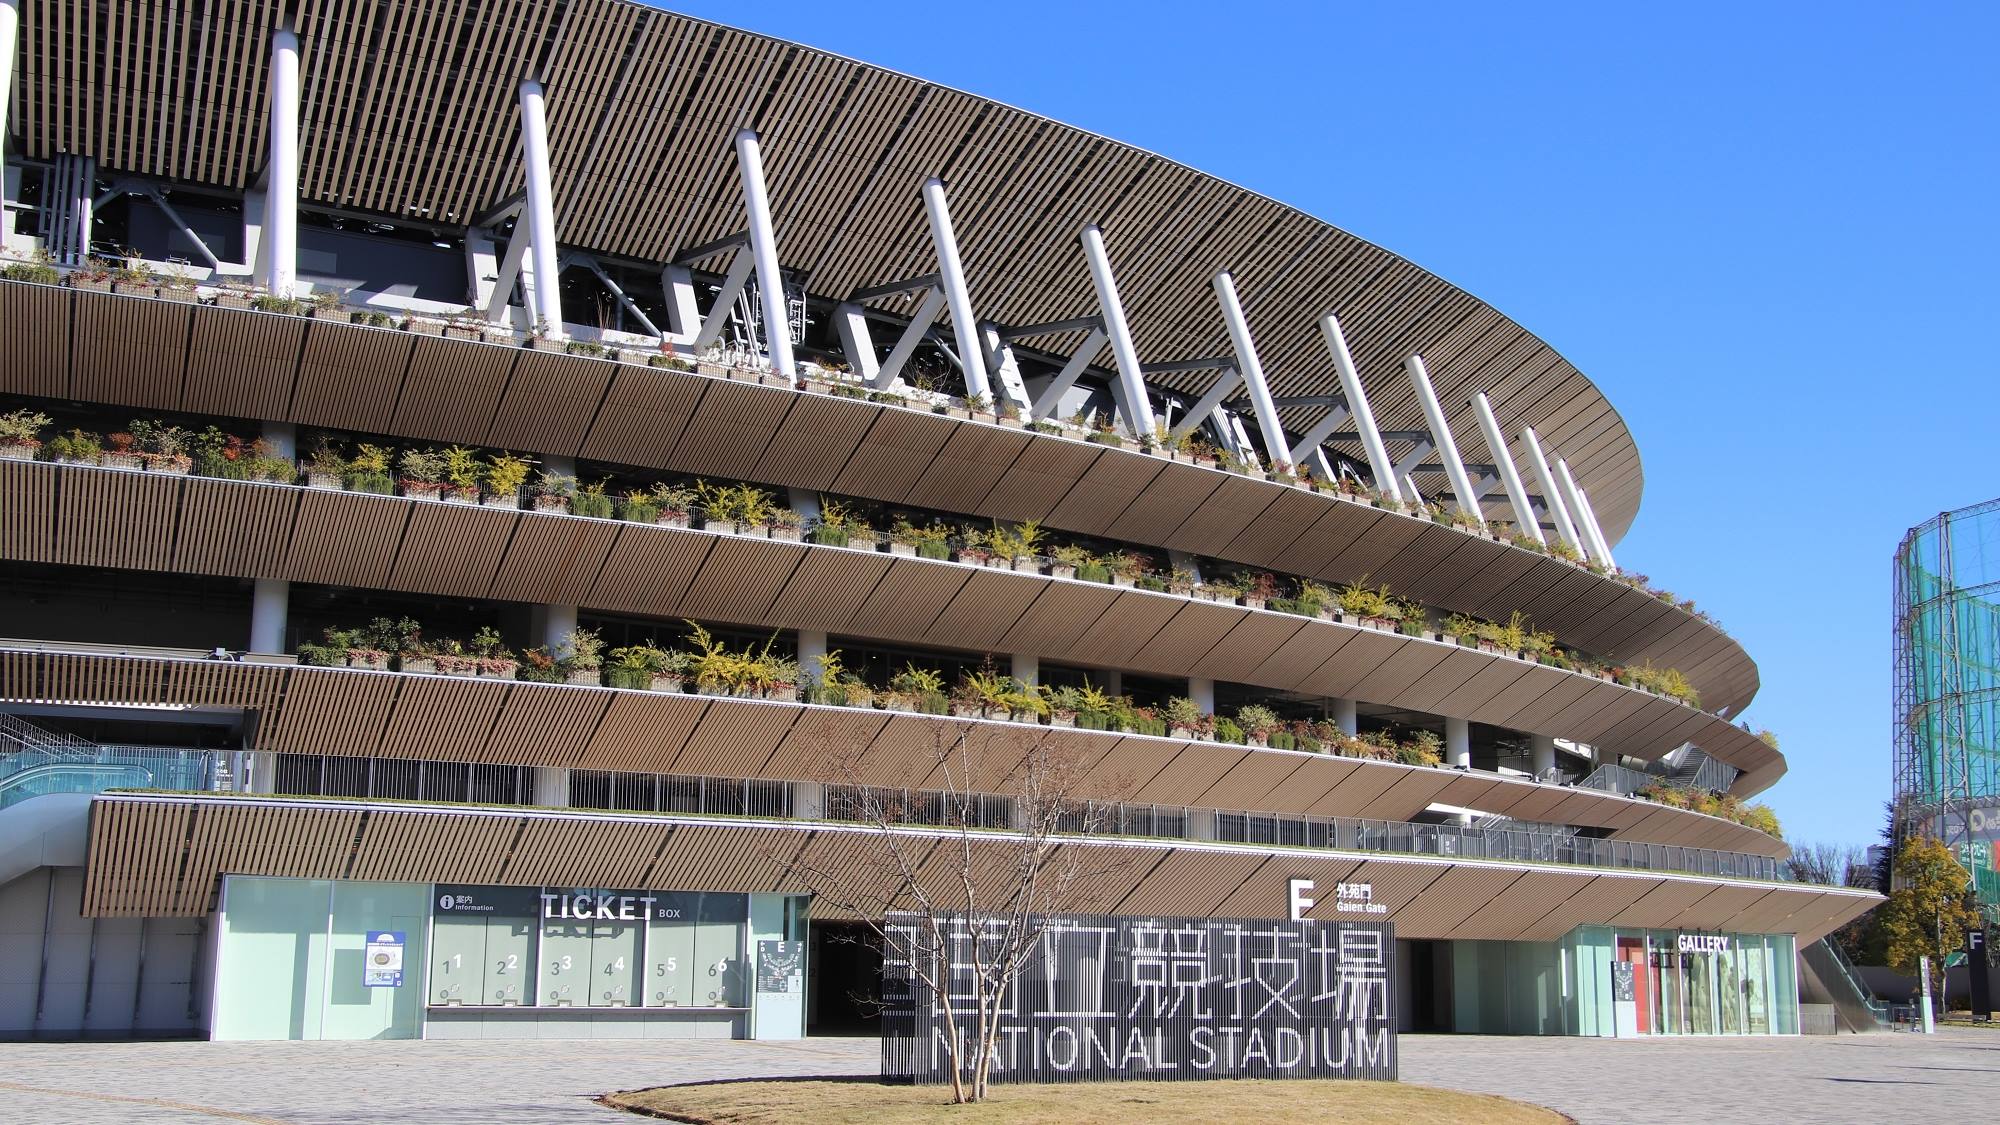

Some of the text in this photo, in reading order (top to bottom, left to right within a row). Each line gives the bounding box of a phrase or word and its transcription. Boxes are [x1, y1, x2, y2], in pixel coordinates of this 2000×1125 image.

[1336, 882, 1372, 899] 外苑門
[455, 895, 473, 904] 案内
[540, 894, 680, 920] TICKET BOX
[1290, 879, 1314, 922] E
[1337, 901, 1387, 913] Gaien Gate
[777, 941, 785, 953] E
[1678, 934, 1729, 954] GALLERY
[1969, 932, 1982, 950] F
[453, 953, 462, 968] 1
[507, 954, 518, 969] 2
[561, 955, 572, 970] 3
[614, 956, 625, 971] 4
[666, 957, 677, 971] 5
[718, 958, 728, 972] 6
[931, 1025, 1389, 1071] NATIONAL STADIUM
